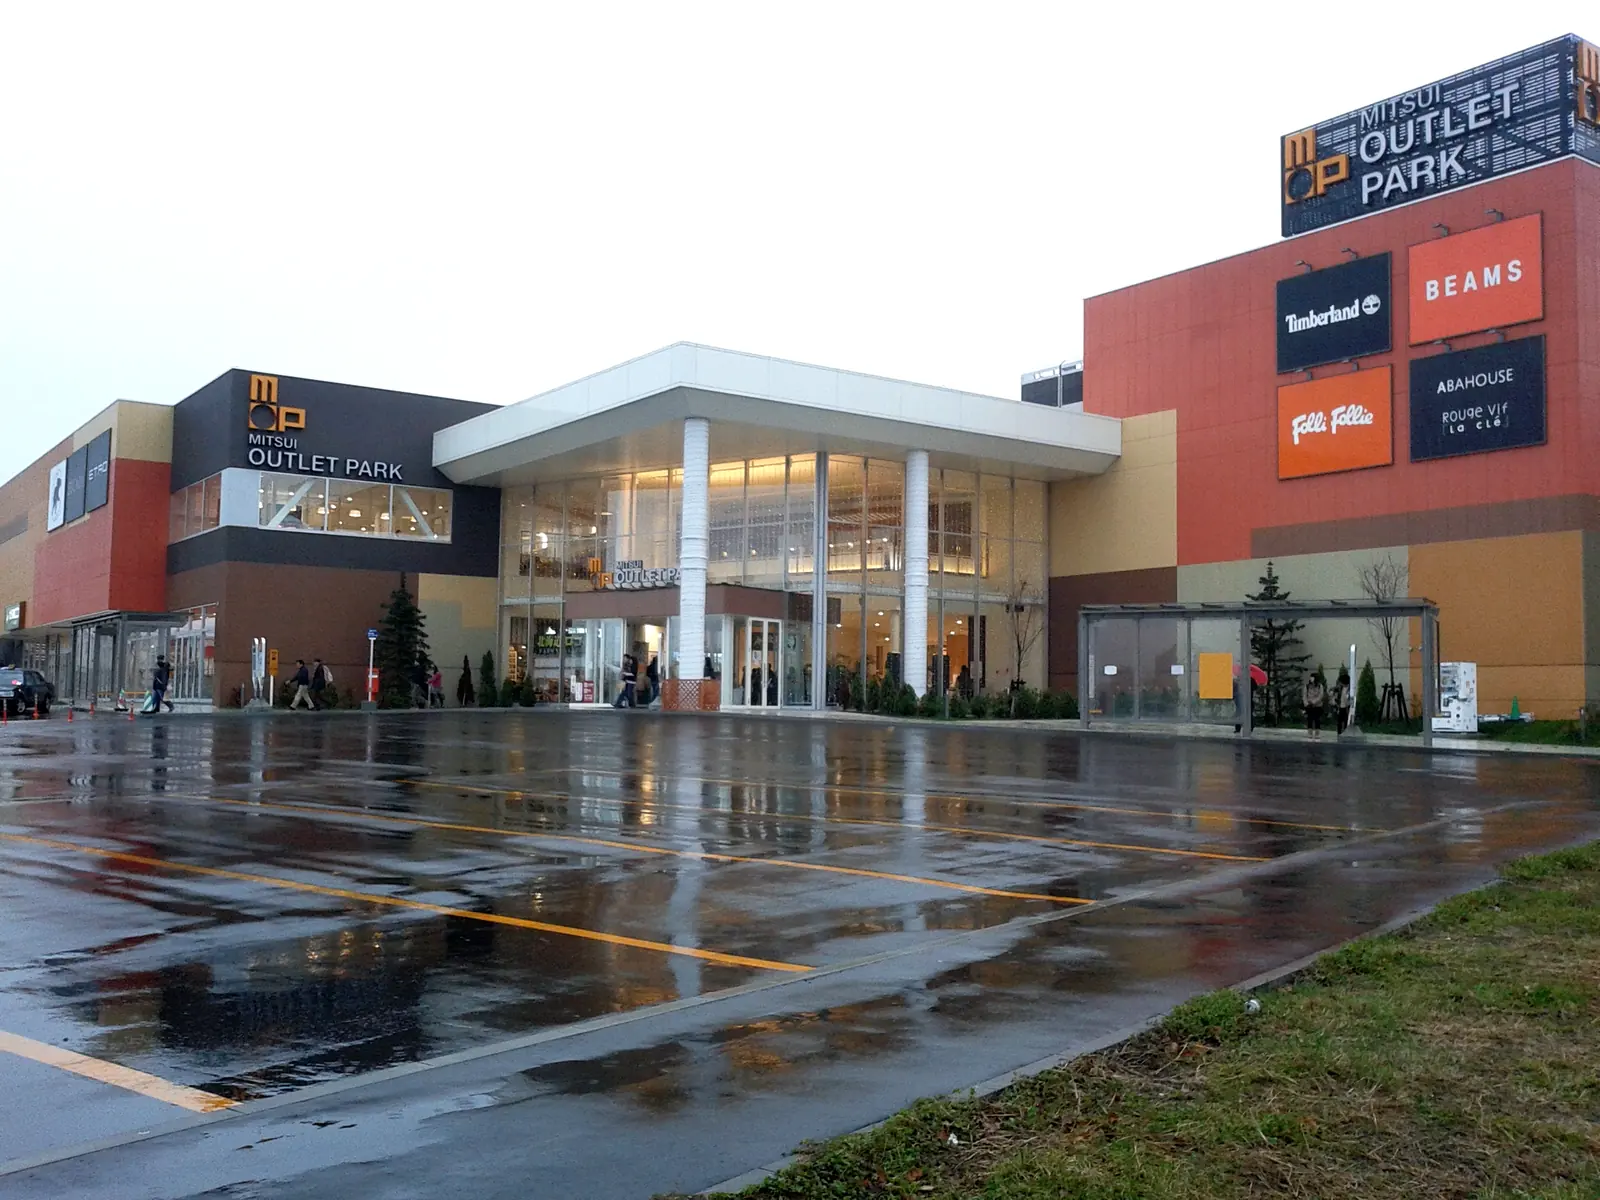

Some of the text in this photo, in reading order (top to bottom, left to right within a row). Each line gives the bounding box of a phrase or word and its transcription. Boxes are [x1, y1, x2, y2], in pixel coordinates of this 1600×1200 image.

[1360, 83, 1441, 129] MITSUI
[1359, 82, 1520, 164] OUTLET
[1361, 144, 1467, 205] PARK
[1425, 259, 1523, 301] BEAMS
[1285, 299, 1360, 333] Timberland
[1436, 368, 1514, 394] ABAHOUSE
[1291, 403, 1374, 444] Folli Follie
[248, 433, 298, 449] MITSUI
[88, 460, 108, 481] ETRO
[248, 448, 403, 480] OUTLET PARK
[615, 568, 681, 583] OUTLET PA
[616, 560, 642, 569] MITSUI
